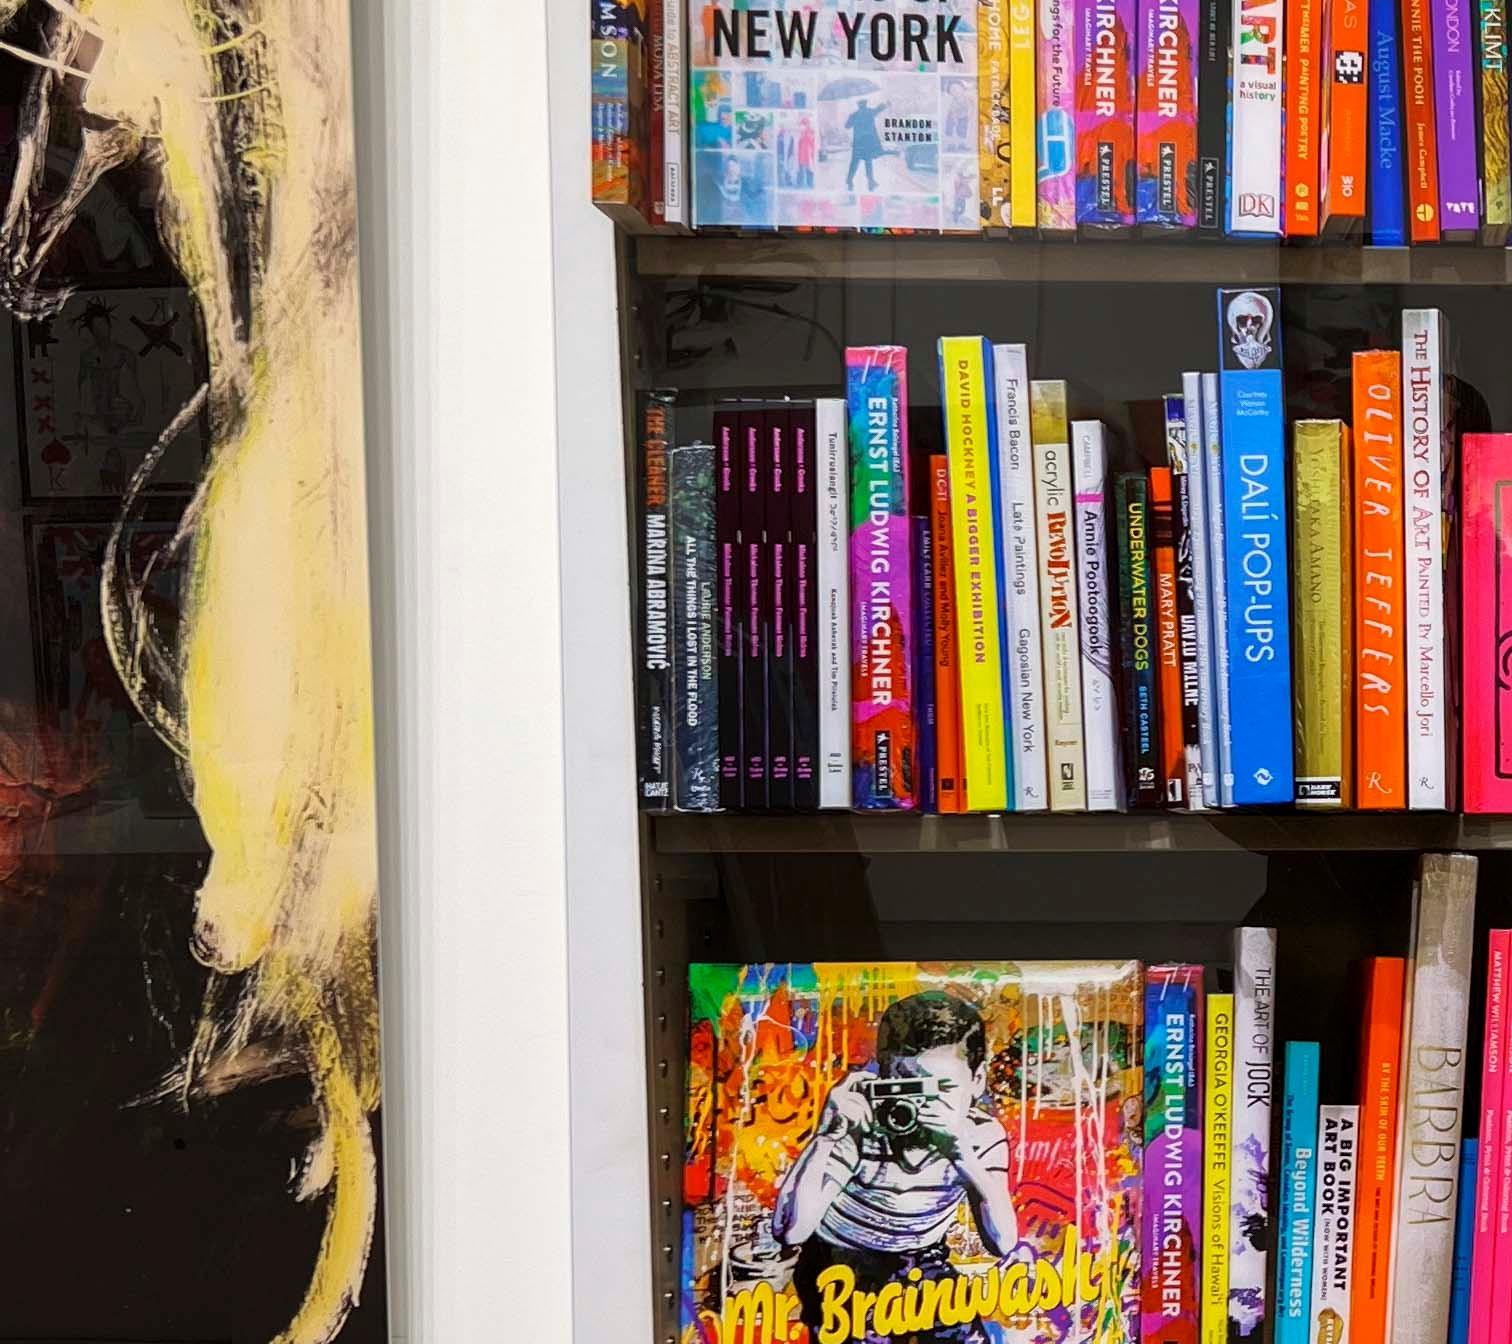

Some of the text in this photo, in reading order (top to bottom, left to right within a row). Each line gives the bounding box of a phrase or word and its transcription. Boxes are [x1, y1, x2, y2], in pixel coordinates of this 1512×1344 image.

[713, 8, 963, 64] NEW YORK
[1484, 8, 1503, 70] KLIMT
[884, 117, 932, 129] BRANDON
[884, 131, 932, 143] STANTON
[647, 515, 666, 575] MARINA
[868, 397, 892, 706] ERNST LUDWIG KIRCHNER
[956, 359, 985, 664] DAVID HOCKNEY A BIGGER EXHIBITION
[1129, 503, 1149, 671] UNDERWATER DOGS
[1240, 454, 1278, 663] DALÍ POP-UPS
[1360, 383, 1392, 716] OLIVER JEFFERS
[1162, 1014, 1184, 1318] ERNST LUDWIG KIRCHNER
[1323, 1119, 1338, 1215] ART BOOK
[1335, 1119, 1353, 1290] A BIG IMPORTANT
[1407, 1047, 1463, 1225] BARBRA
